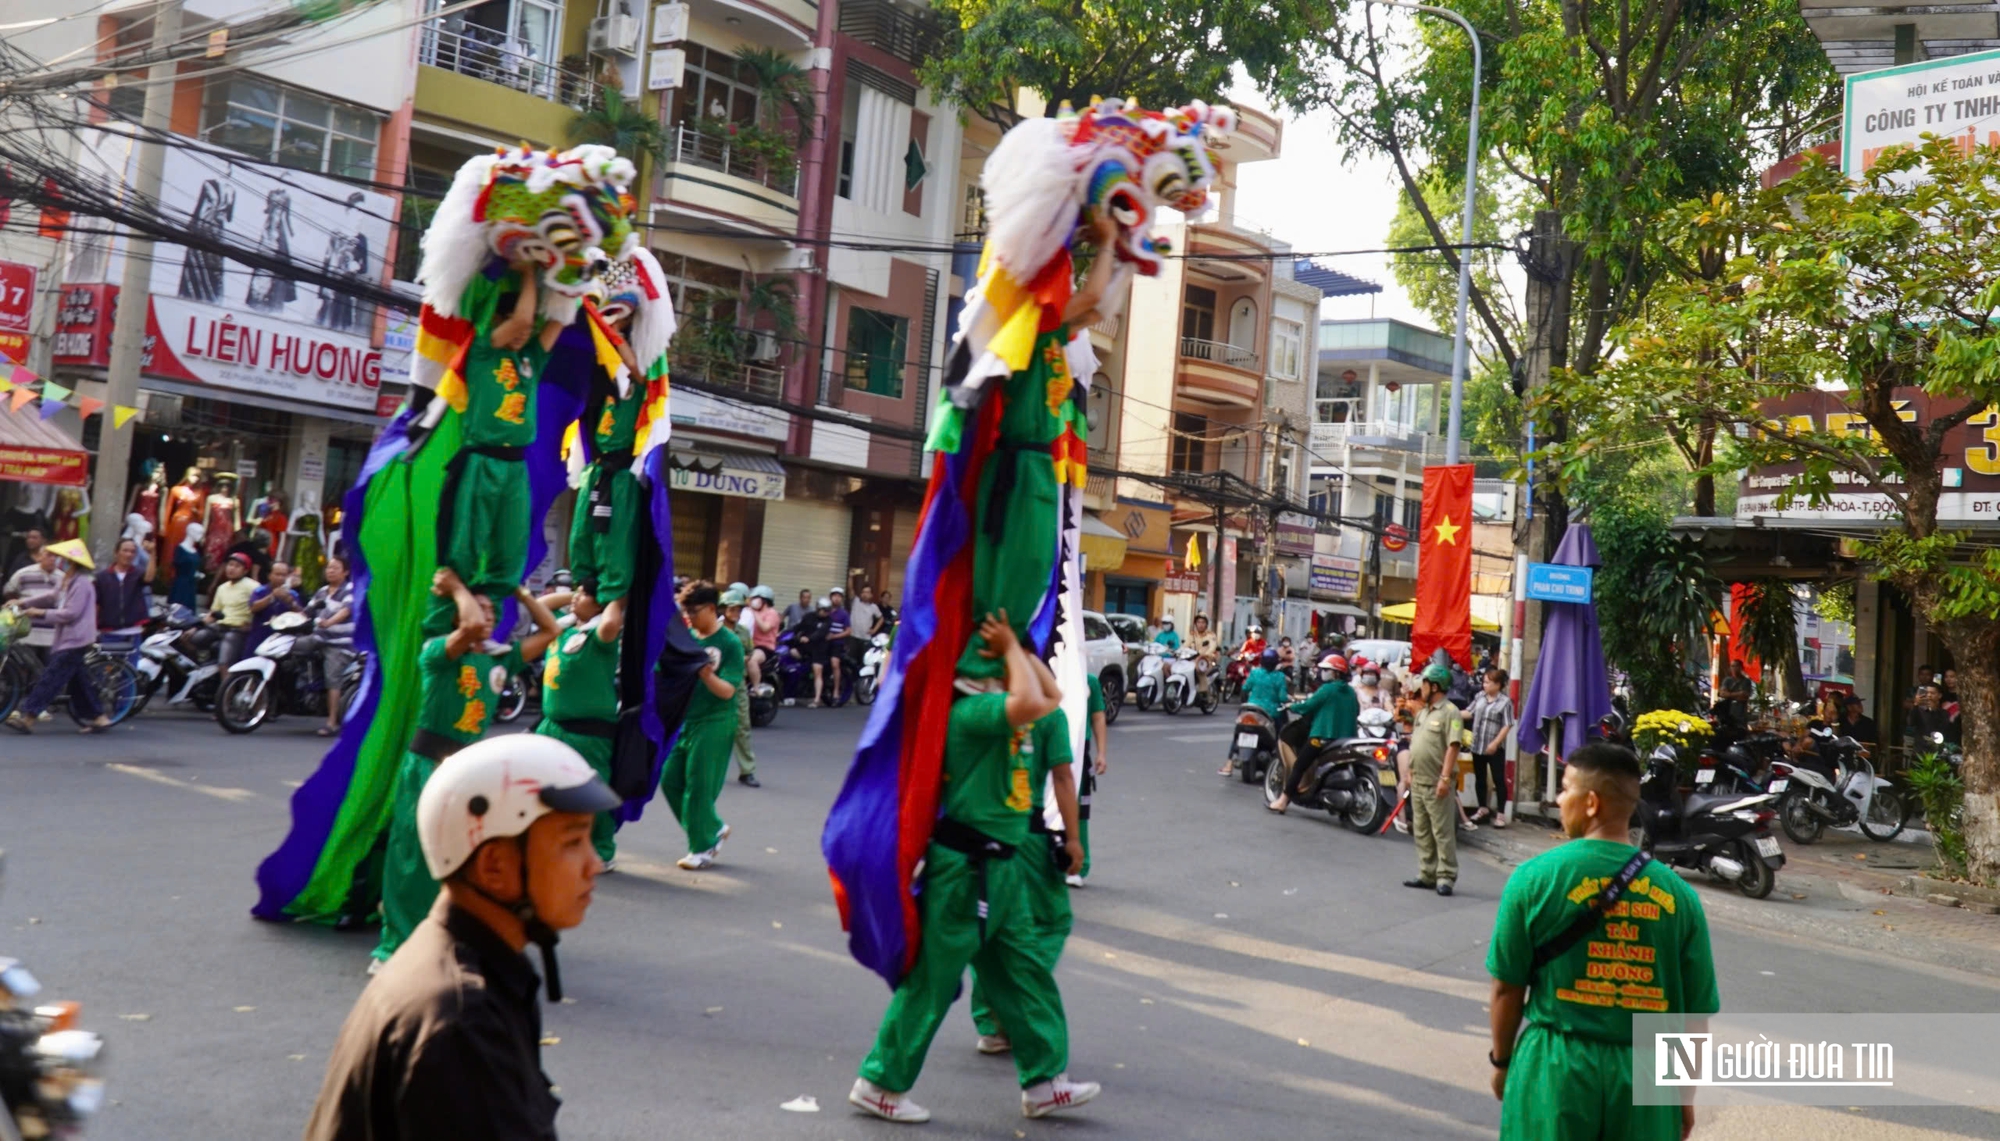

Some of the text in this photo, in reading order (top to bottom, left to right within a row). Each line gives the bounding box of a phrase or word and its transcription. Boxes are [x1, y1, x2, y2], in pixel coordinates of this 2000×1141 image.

[1907, 84, 1927, 98] HỘI
[1933, 78, 1948, 93] KẾ
[1952, 75, 1983, 90] TOÁN
[1865, 108, 1916, 133] CÔNG
[1924, 103, 1947, 124] TY
[12, 287, 25, 305] 7
[186, 313, 262, 367] LIÊN
[270, 332, 382, 388] HƯƠNG
[1833, 498, 1856, 512] HÒA
[1973, 501, 1991, 512] ĐT:
[1605, 921, 1639, 941] TÁI
[1587, 940, 1656, 963] KHÁNH
